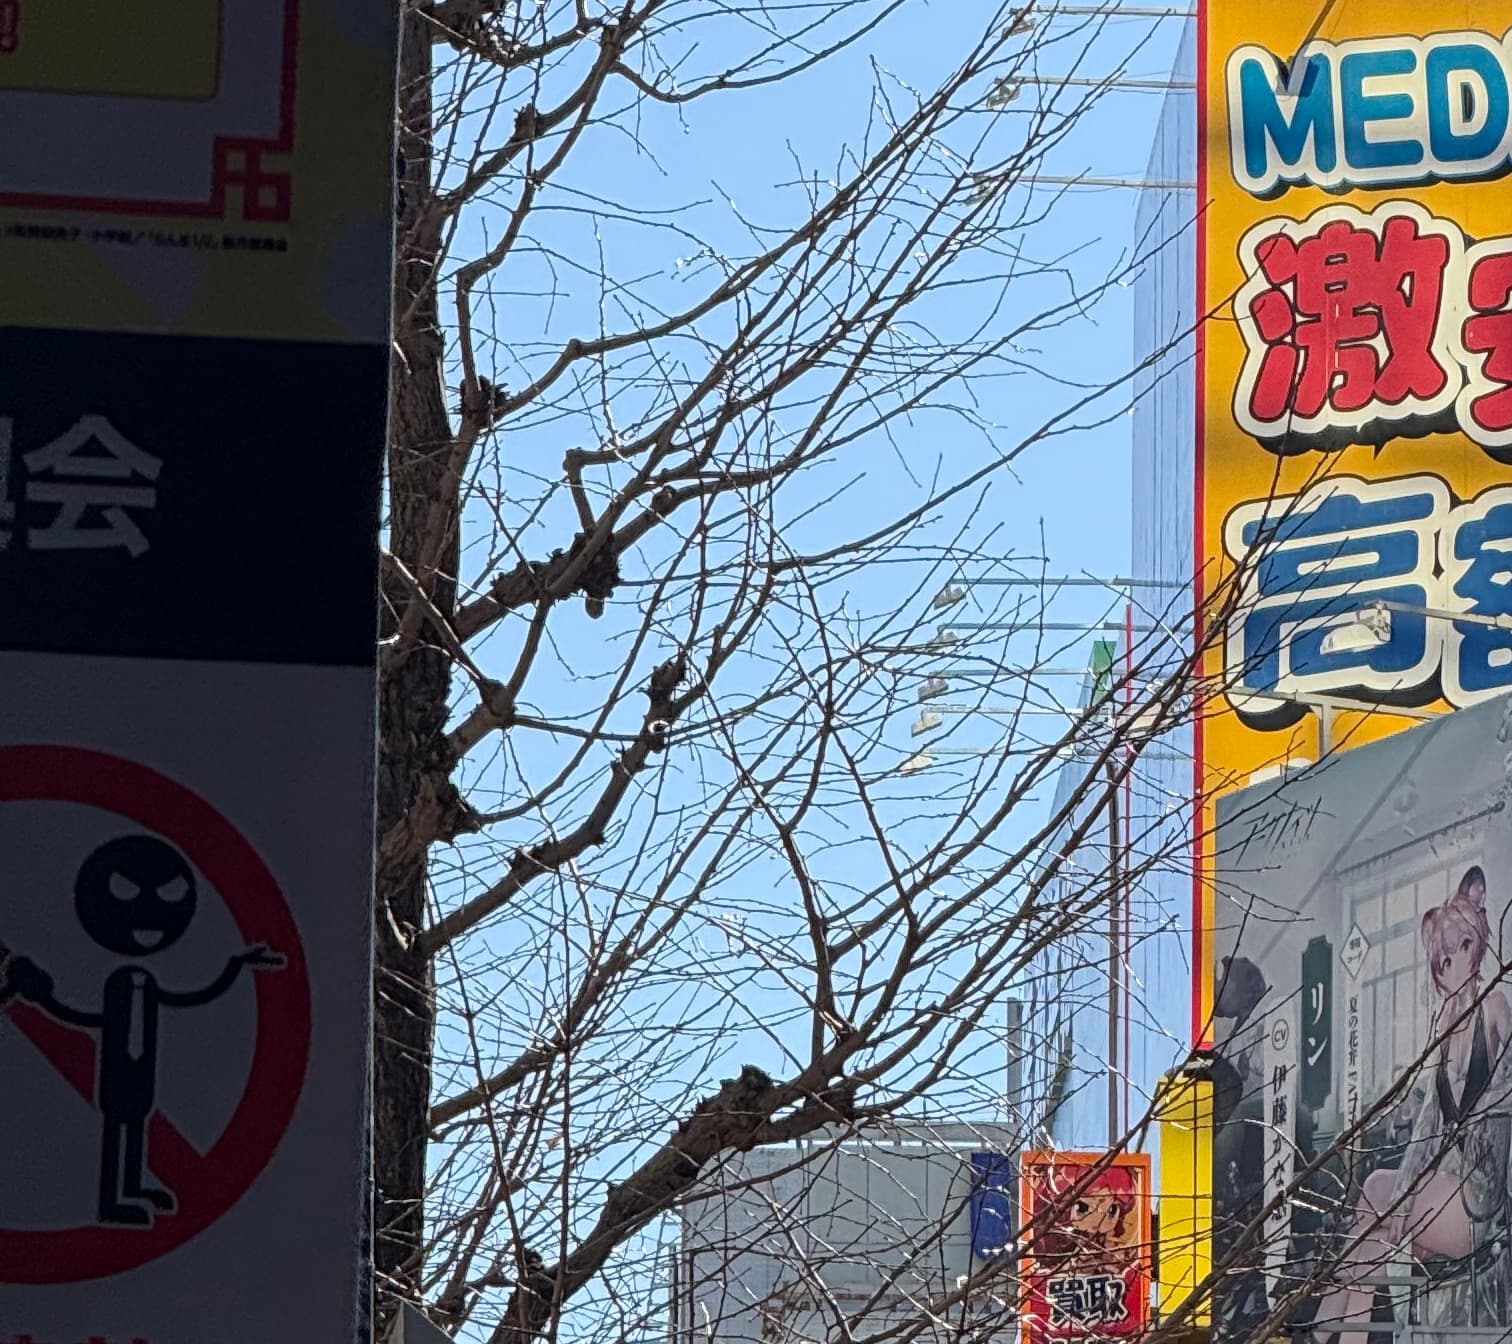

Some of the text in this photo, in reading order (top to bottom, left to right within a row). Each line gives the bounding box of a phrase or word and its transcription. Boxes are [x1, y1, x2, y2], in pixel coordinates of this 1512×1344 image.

[0, 412, 164, 558] 会
[1275, 1028, 1288, 1041] CV
[1309, 982, 1328, 1067] リン
